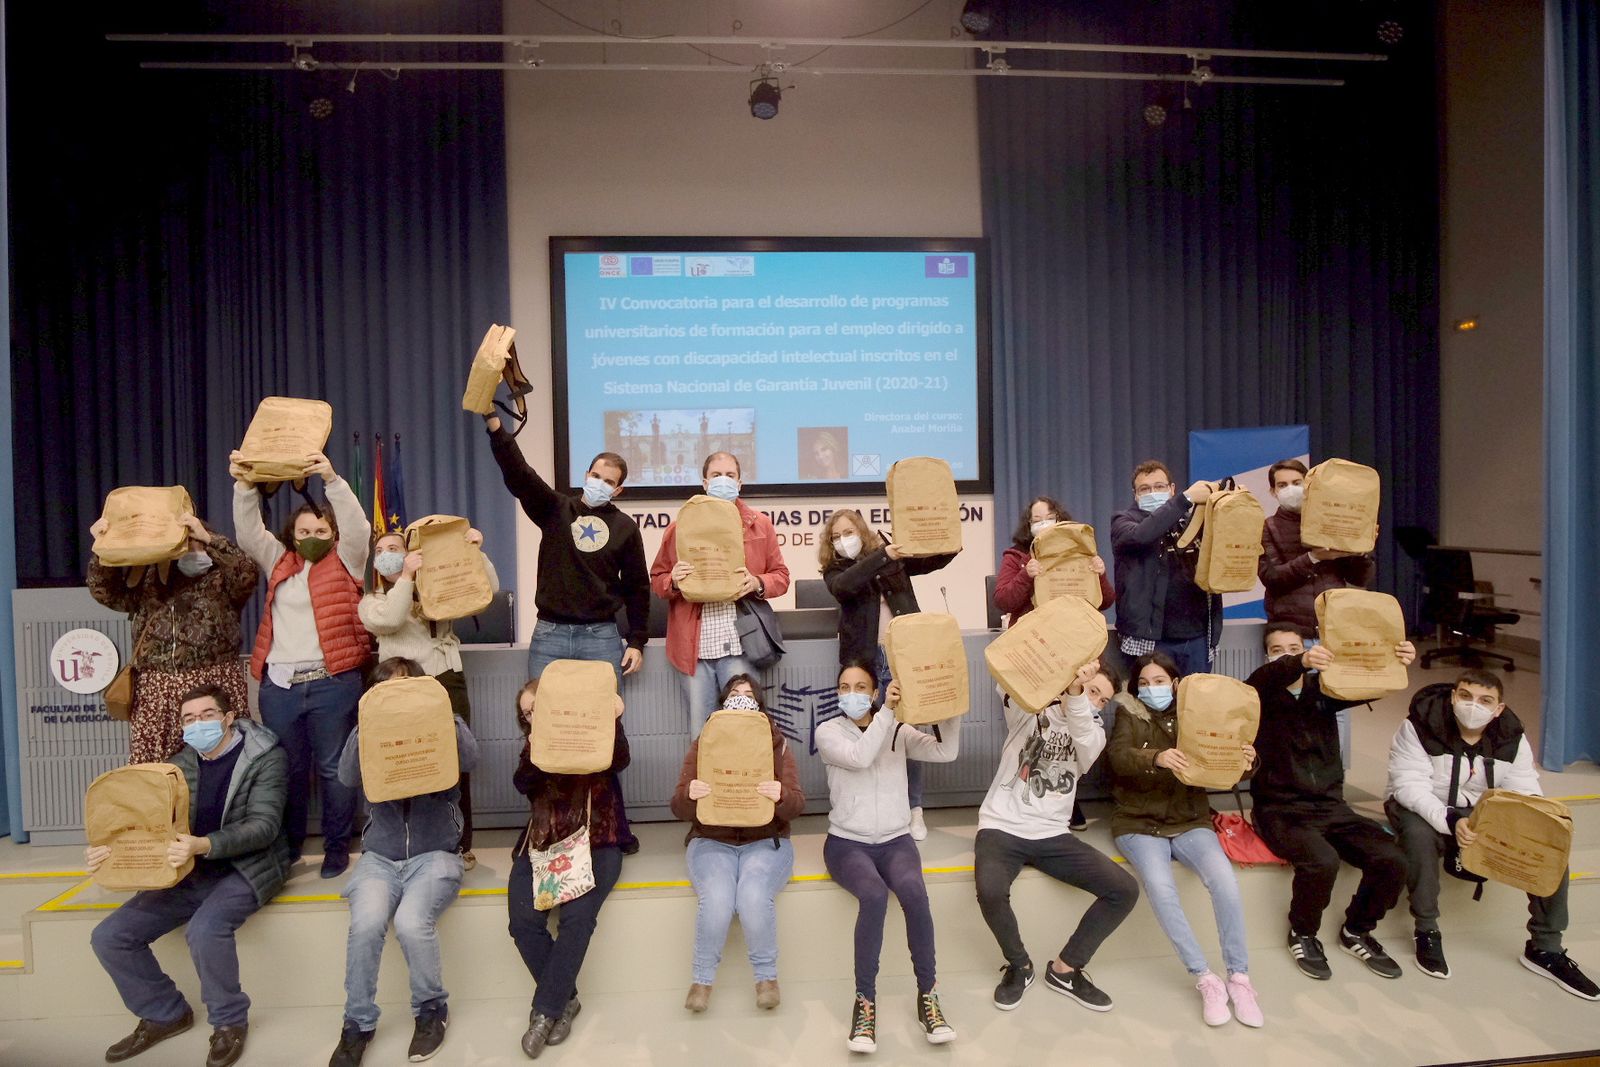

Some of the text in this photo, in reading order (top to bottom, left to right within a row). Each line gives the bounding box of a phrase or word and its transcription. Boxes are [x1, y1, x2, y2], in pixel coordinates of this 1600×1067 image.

[599, 294, 950, 312] IV Convocatoria para el desarrollo de programas
[584, 321, 964, 339] universitarios de formación para el empleo dirigido a
[591, 348, 958, 369] jóvenes con discapacidad intelectual inscritos en el
[603, 376, 949, 395] Sistema Nacional de Garantía Juvenil (2020-21)
[864, 412, 911, 421] Directora
[914, 411, 929, 421] del
[891, 424, 926, 433] Anabel
[632, 513, 671, 528] TAD
[791, 532, 815, 546] DE
[30, 703, 81, 714] FACULTAD
[83, 703, 97, 713] DE
[44, 714, 58, 724] DE
[60, 714, 74, 724] LA
